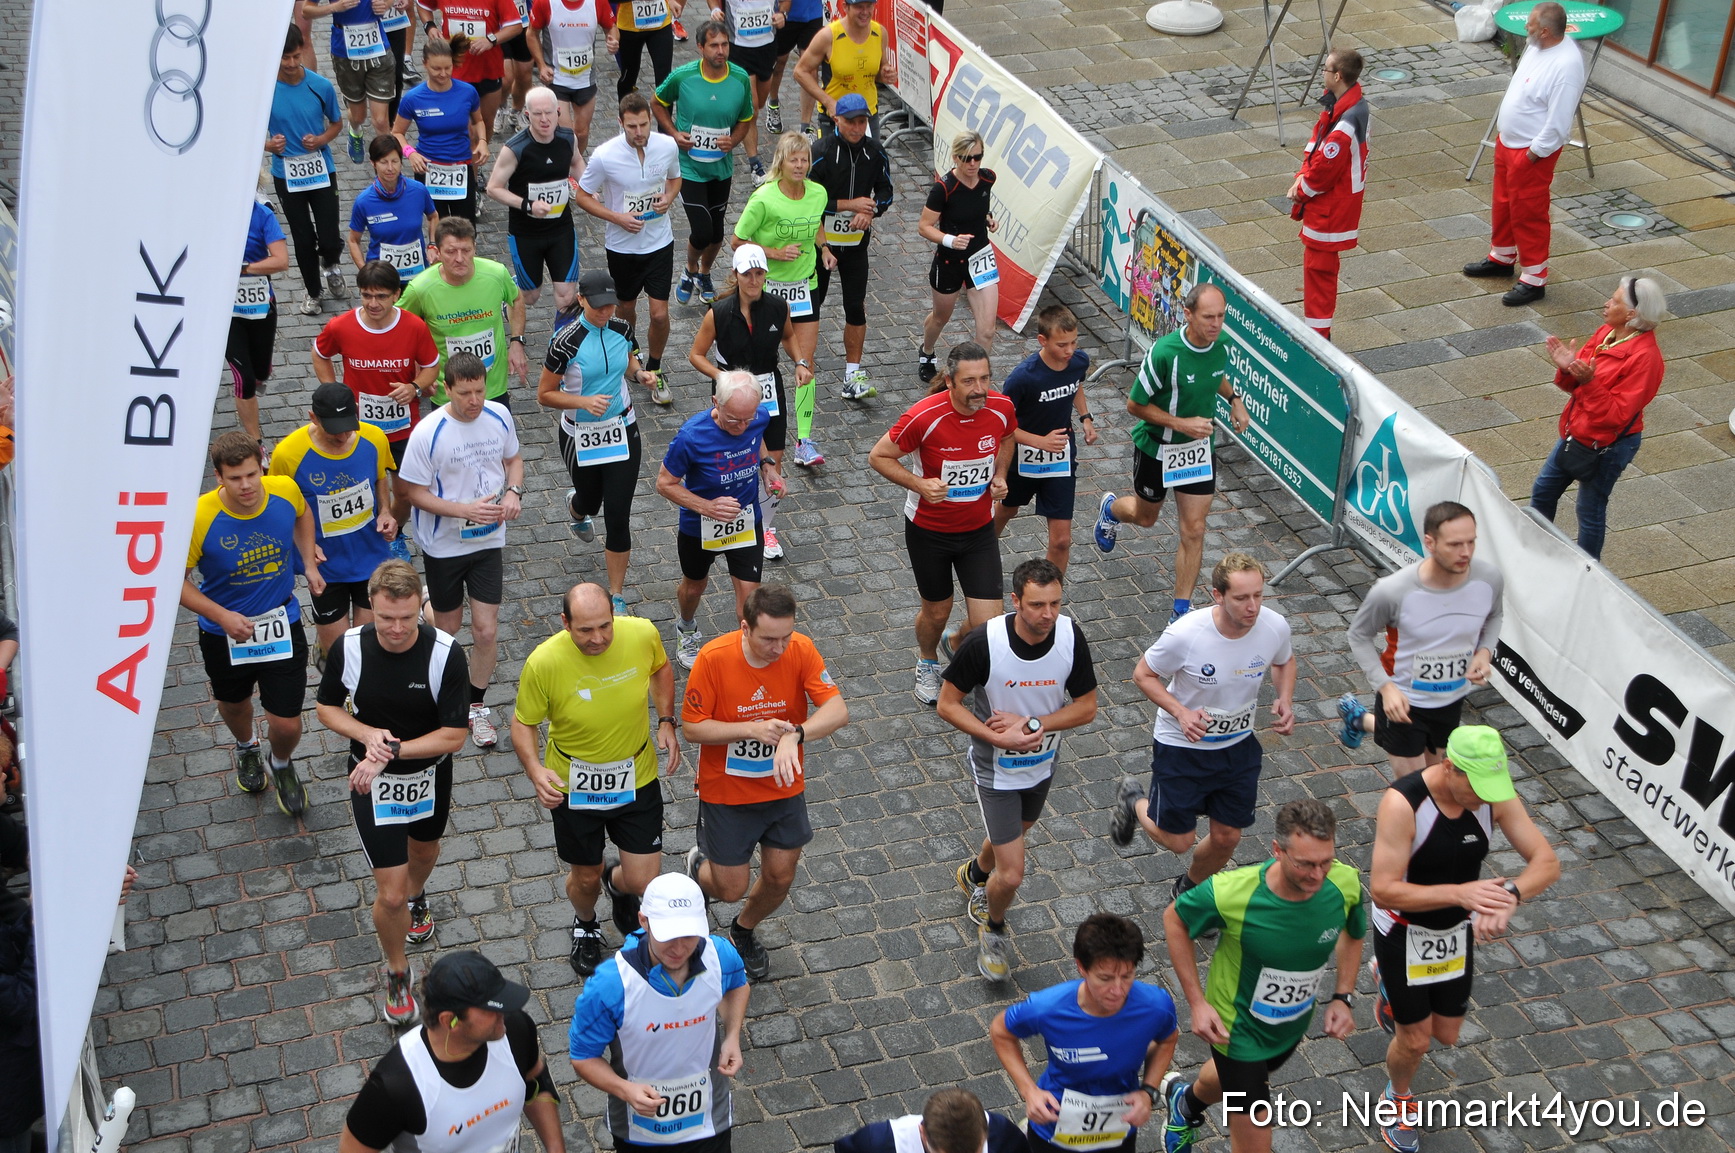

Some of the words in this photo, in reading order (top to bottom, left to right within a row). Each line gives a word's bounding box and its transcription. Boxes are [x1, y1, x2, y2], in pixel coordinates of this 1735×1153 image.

[445, 6, 483, 19] NEUMARKT
[637, 1, 665, 18] 2074
[460, 22, 475, 36] 18
[741, 14, 769, 28] 2352
[349, 30, 379, 47] 2218
[567, 55, 588, 67] 198
[694, 136, 720, 150] 343
[290, 160, 323, 177] 3388
[431, 171, 464, 186] 2219
[538, 190, 562, 204] 657
[629, 197, 661, 213] 237
[834, 219, 851, 233] 63
[237, 287, 267, 304] 355
[437, 307, 483, 320] autoladen
[449, 310, 494, 325] neumarkt
[125, 240, 189, 446] BKK
[349, 357, 403, 368] NEUMARKT
[1229, 346, 1289, 413] Sicherheit
[364, 402, 405, 419] 3346
[580, 428, 622, 448] 3349
[1168, 447, 1207, 469] 2392
[1260, 442, 1283, 470] 09181
[720, 472, 734, 482] DU
[947, 467, 989, 487] 2524
[1173, 468, 1202, 480] Reinhard
[331, 495, 365, 519] 644
[713, 518, 745, 539] 268
[1378, 533, 1402, 557] Service
[96, 492, 168, 714] Audi
[247, 645, 276, 657] Patrick
[1420, 658, 1467, 681] 2313
[1020, 680, 1057, 688] KLEBL
[1500, 656, 1517, 678] die
[1518, 672, 1569, 728] verbinden
[737, 699, 787, 713] SportScheck
[1206, 712, 1251, 734] 2928
[571, 763, 593, 771] PARTL
[594, 763, 625, 773] Neumarkt
[577, 770, 629, 791] 2097
[379, 779, 429, 803] 2862
[587, 793, 618, 804] Markus
[391, 805, 418, 816] Markus
[1602, 747, 1735, 892] stadtwerk
[1422, 935, 1458, 961] 294
[664, 1015, 708, 1030] KLEBL
[662, 1080, 698, 1093] Neumarkt
[467, 1098, 510, 1127] KLEBL
[654, 1121, 683, 1135] Georg
[1081, 1111, 1112, 1132] 97
